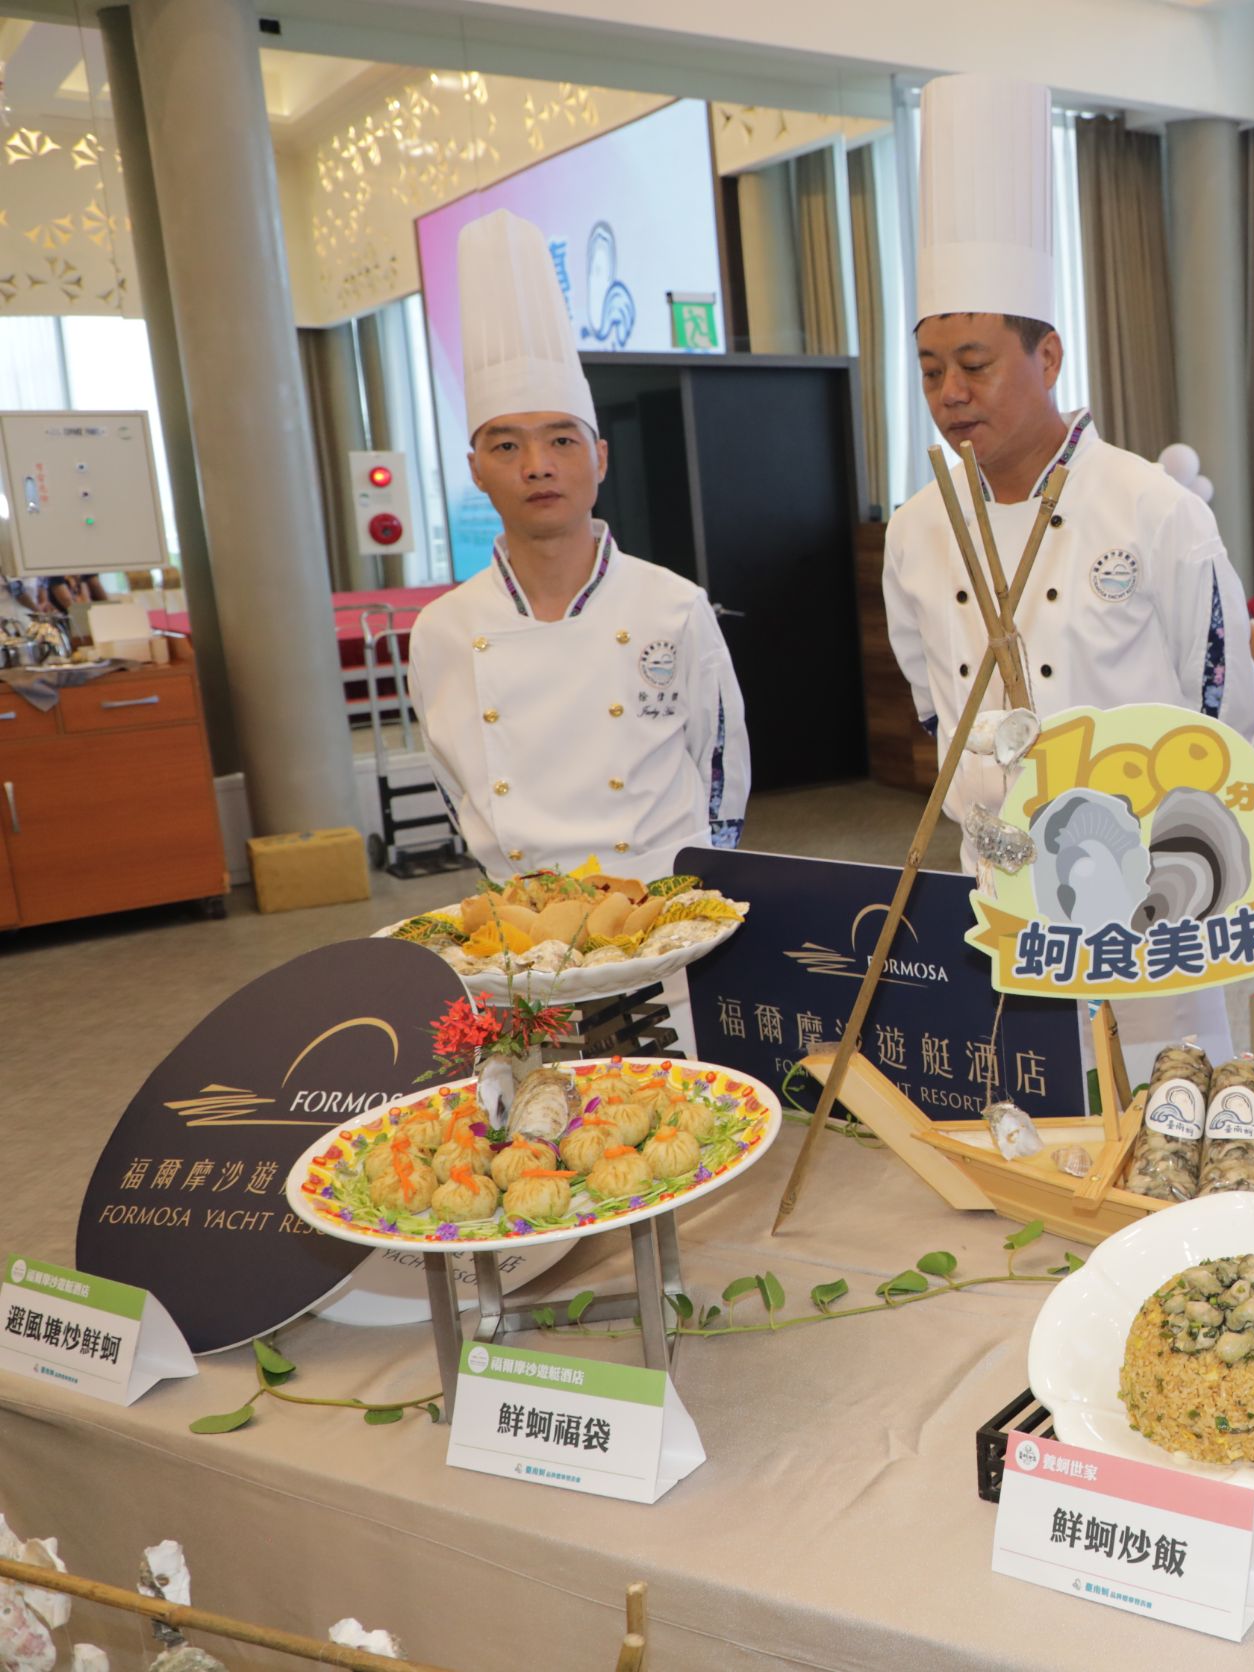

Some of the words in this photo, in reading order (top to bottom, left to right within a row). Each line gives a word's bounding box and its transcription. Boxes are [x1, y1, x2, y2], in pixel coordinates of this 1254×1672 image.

[119, 1157, 287, 1197] 福爾摩沙遊
[99, 1205, 191, 1227] FORMOSA
[199, 1209, 275, 1232] YACHT
[5, 1304, 122, 1365] 避風塘炒鮮蚵
[491, 1356, 585, 1385] 福爾摩沙遊艇酒店
[497, 1402, 611, 1453] 鮮蚵福袋
[1043, 1453, 1098, 1481] 養蚵世家
[1050, 1507, 1189, 1578] 鮮蚵炒飯
